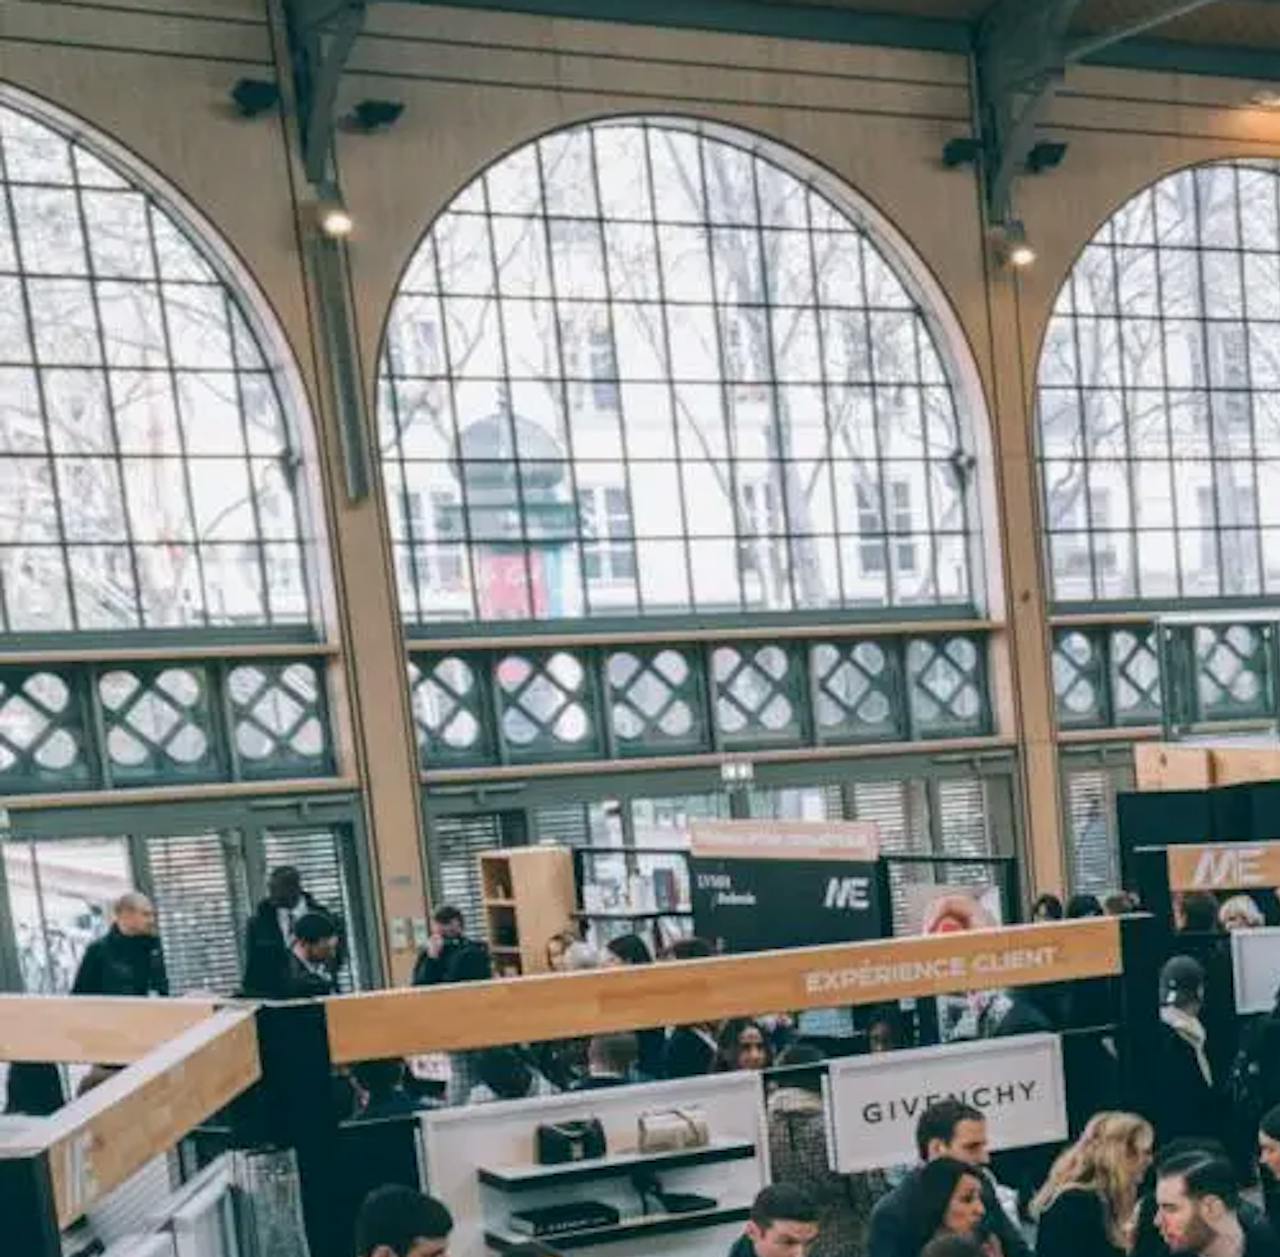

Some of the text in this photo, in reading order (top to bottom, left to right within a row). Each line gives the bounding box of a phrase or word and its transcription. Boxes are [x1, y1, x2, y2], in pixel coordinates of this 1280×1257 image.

[1194, 848, 1264, 889] ME
[822, 877, 870, 909] ME
[806, 946, 1058, 993] EXPÉRIENCE CLIENT
